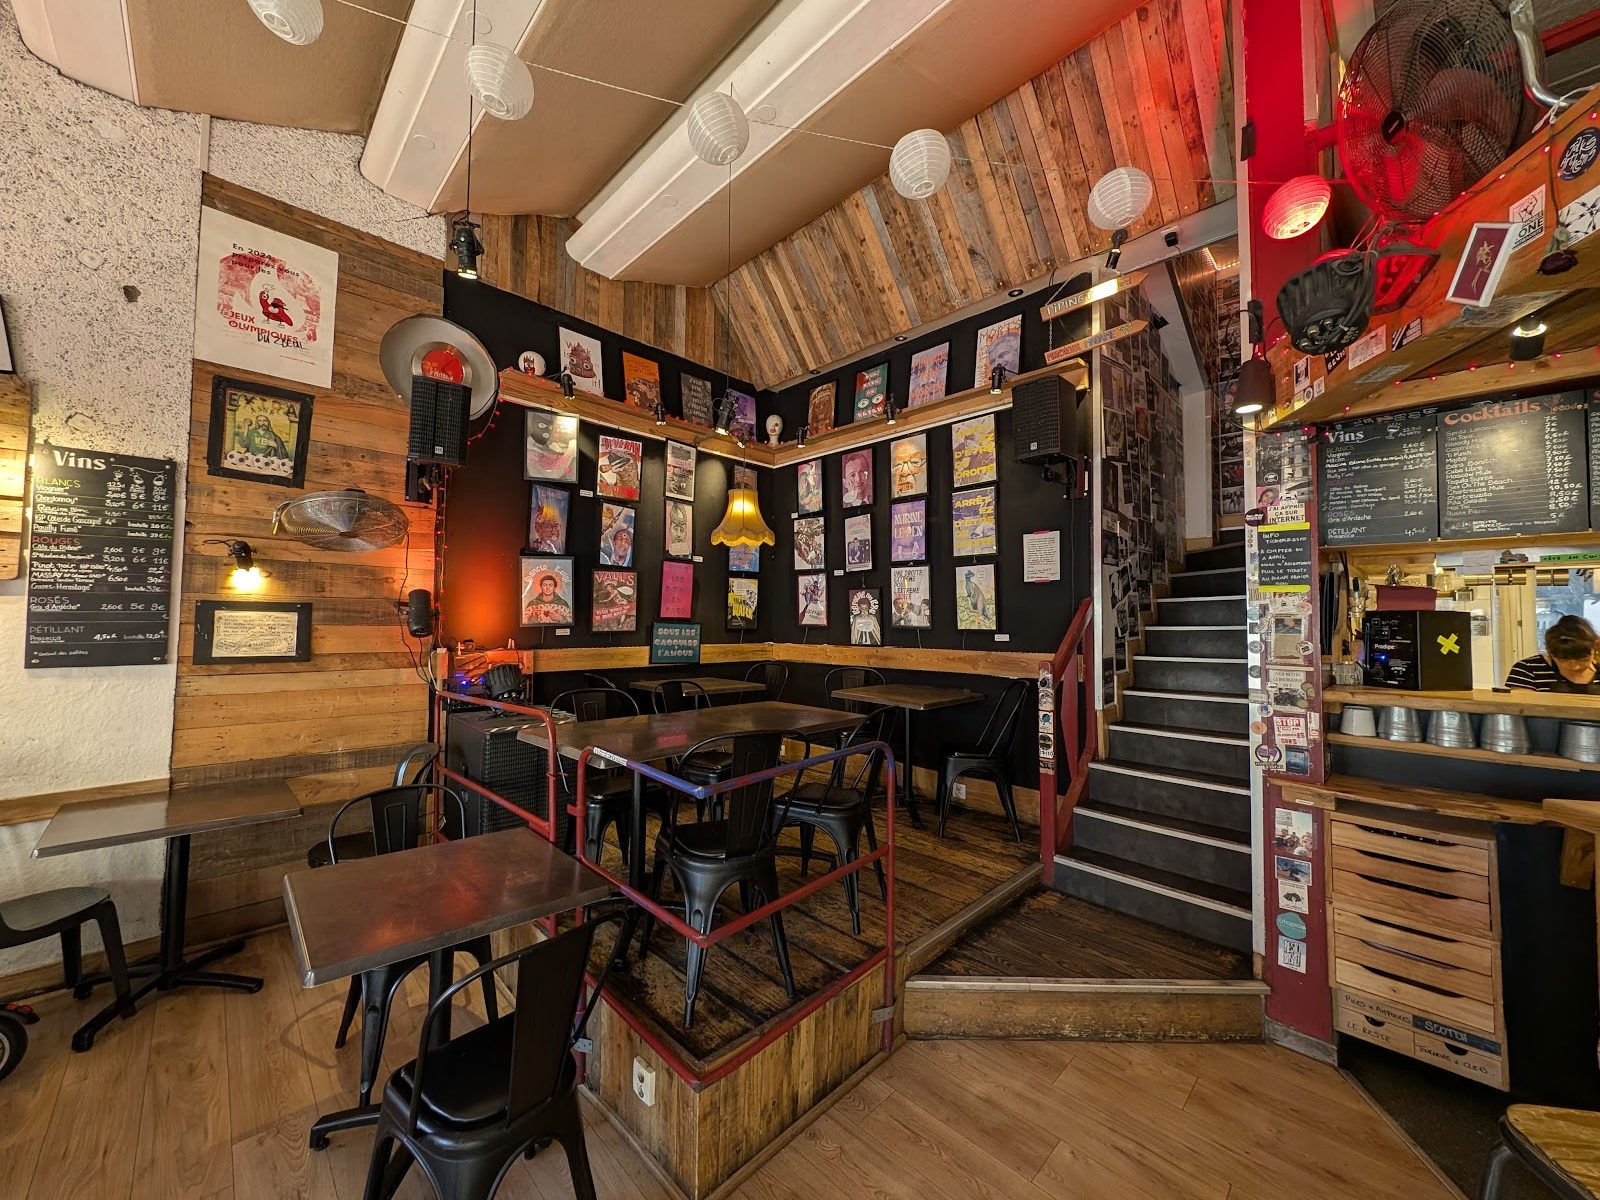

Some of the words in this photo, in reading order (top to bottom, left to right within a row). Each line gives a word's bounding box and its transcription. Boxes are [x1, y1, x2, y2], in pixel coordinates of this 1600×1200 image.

[232, 243, 244, 252] En
[231, 260, 255, 271] pour
[259, 267, 271, 275] les
[278, 266, 300, 277] vous
[229, 311, 255, 323] JEUX
[228, 320, 299, 342] OLYMPIQUES
[1444, 401, 1542, 426] Cocktails
[1328, 430, 1364, 444] Vins
[53, 450, 107, 471] Vins
[954, 464, 994, 479] DROITE
[37, 477, 81, 488] BLANCS
[1447, 488, 1487, 496] Chartreuse
[1269, 514, 1305, 524] INTERNET
[32, 535, 80, 545] ROUGES
[596, 572, 635, 587] VALLS
[30, 596, 69, 604] ROSÉS
[130, 602, 145, 610] 5€
[151, 603, 166, 611] 9€
[30, 625, 86, 634] PÉTILLANT
[1347, 1021, 1358, 1031] LE
[1362, 1027, 1392, 1044] RESTE
